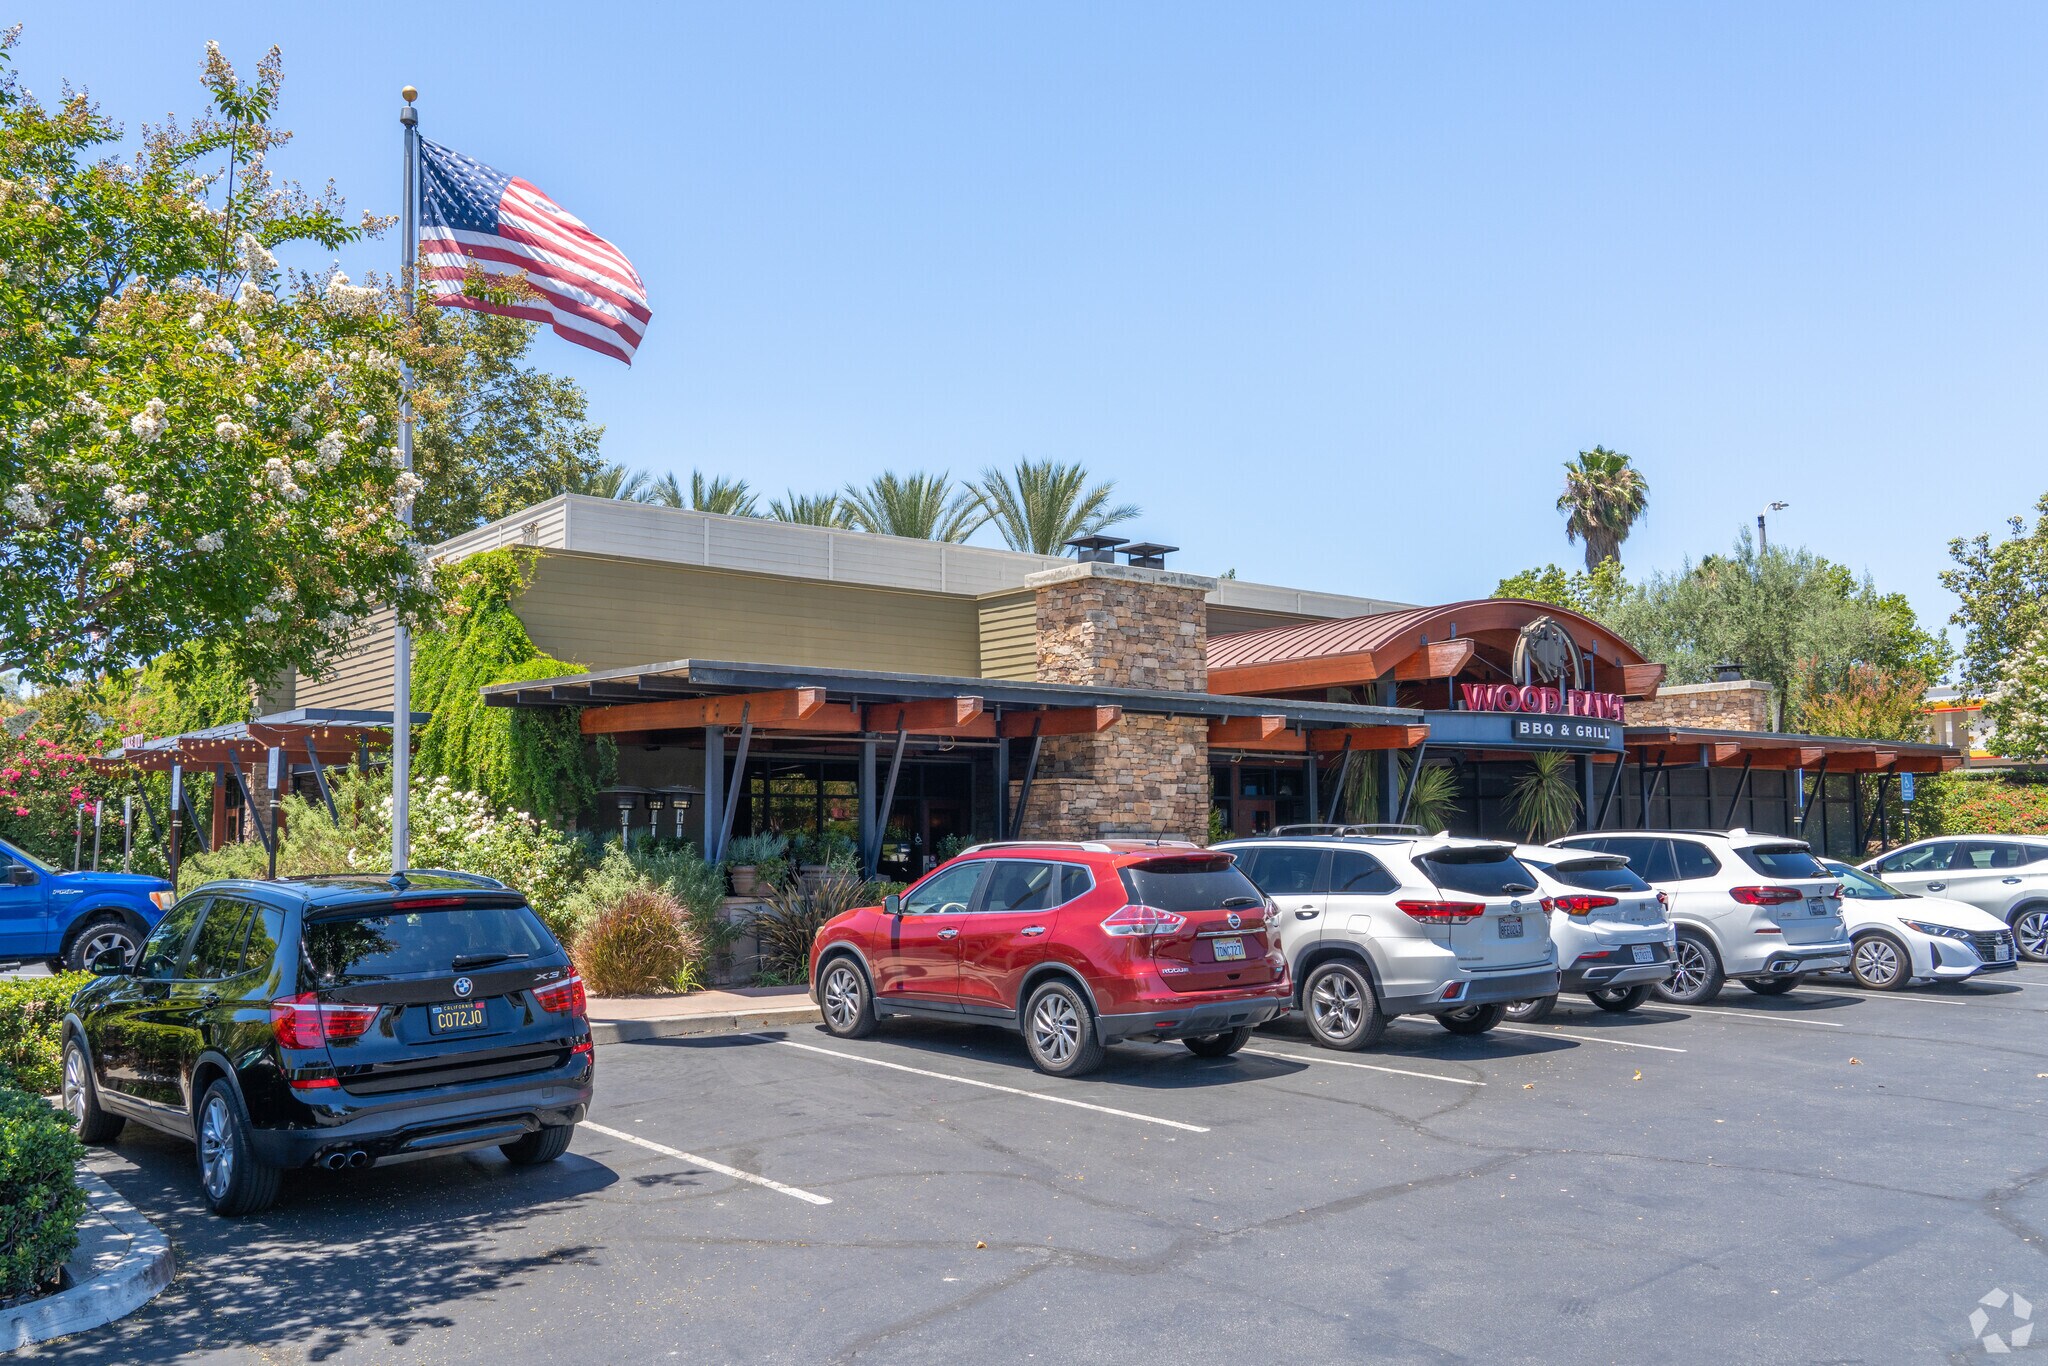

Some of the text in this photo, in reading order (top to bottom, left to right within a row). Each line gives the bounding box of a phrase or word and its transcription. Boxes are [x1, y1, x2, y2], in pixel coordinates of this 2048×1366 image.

[1461, 683, 1562, 714] WOOD
[1520, 722, 1610, 739] BBQ & GRILL
[534, 971, 560, 981] X3
[443, 1002, 474, 1011] CALIFORNIA
